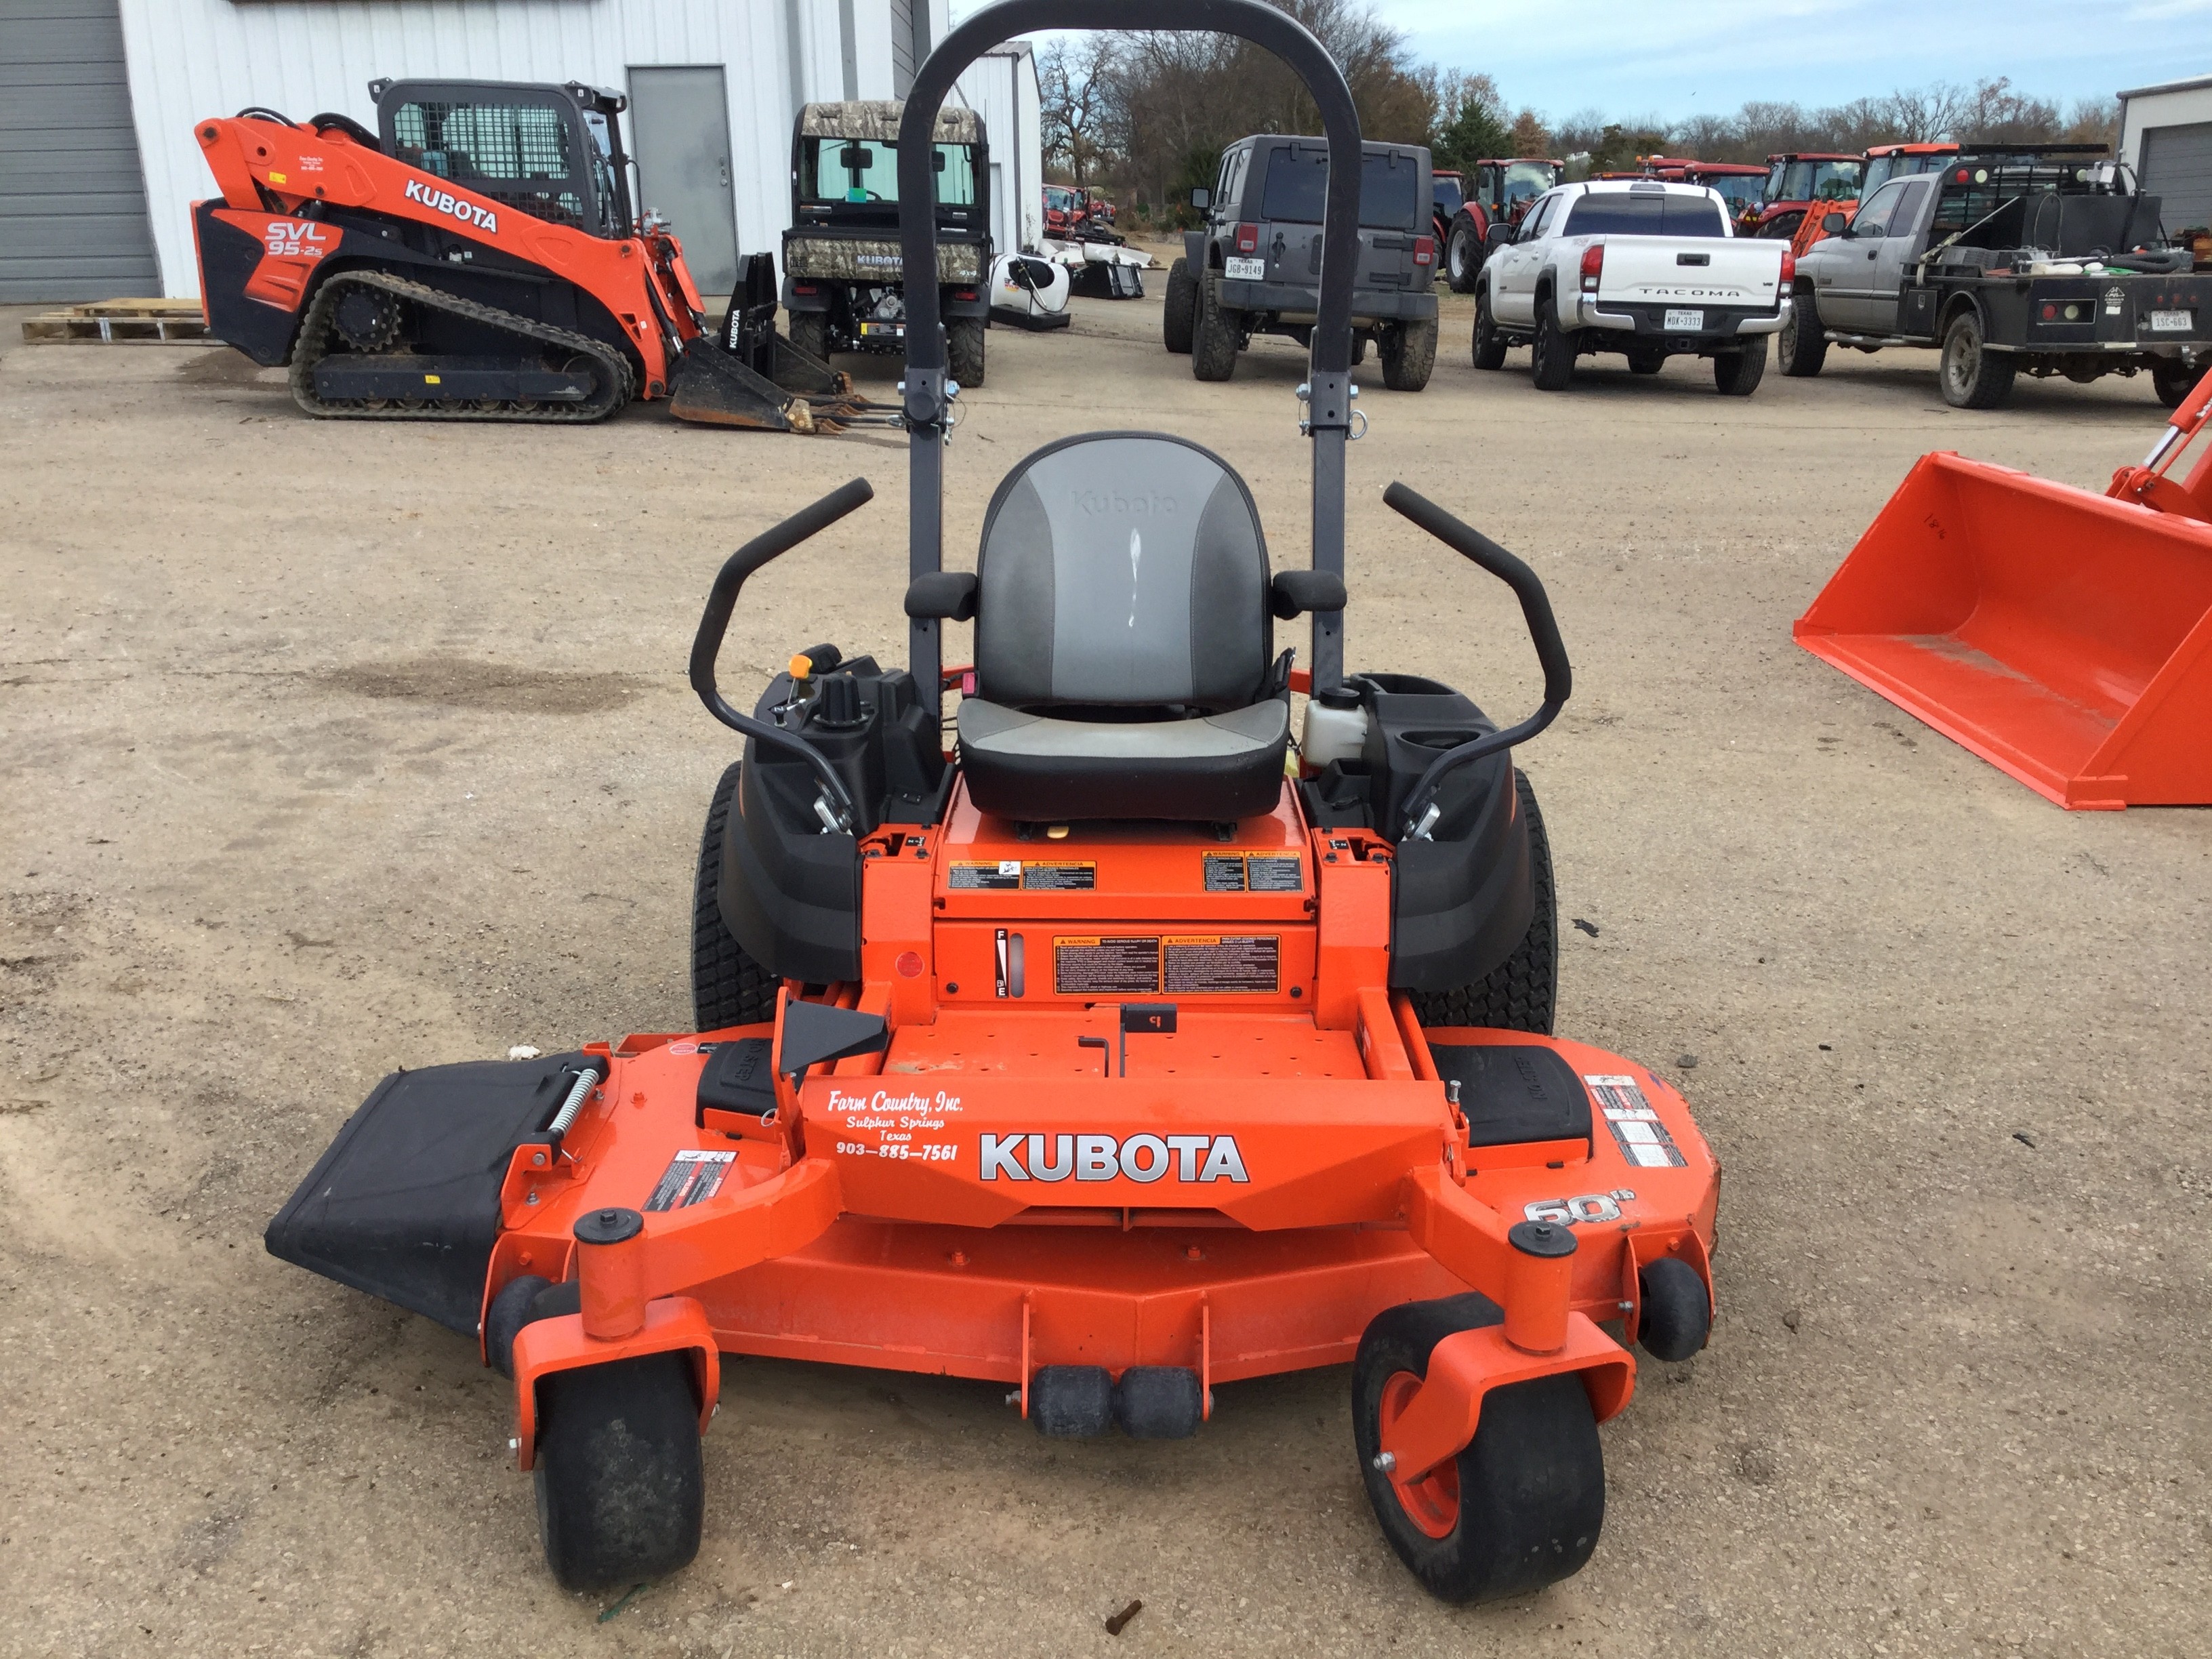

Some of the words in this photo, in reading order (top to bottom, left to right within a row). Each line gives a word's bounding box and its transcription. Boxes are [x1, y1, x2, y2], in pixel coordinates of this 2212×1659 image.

[405, 179, 497, 234] KUBOTA
[265, 222, 326, 241] SVL
[857, 255, 903, 266] KUBOT
[1639, 288, 1740, 297] TACOMA
[729, 309, 740, 348] KUBOTA
[998, 930, 1004, 939] F
[998, 987, 1006, 996] E
[827, 1090, 867, 1112] Farm
[871, 1090, 933, 1117] Country,
[935, 1090, 964, 1112] Inc.
[846, 1115, 895, 1130] Sulphur
[899, 1116, 945, 1130] Springs
[880, 1130, 912, 1141] Texas
[836, 1141, 958, 1161] 903-885-7561
[979, 1132, 1250, 1183] KUBOTA
